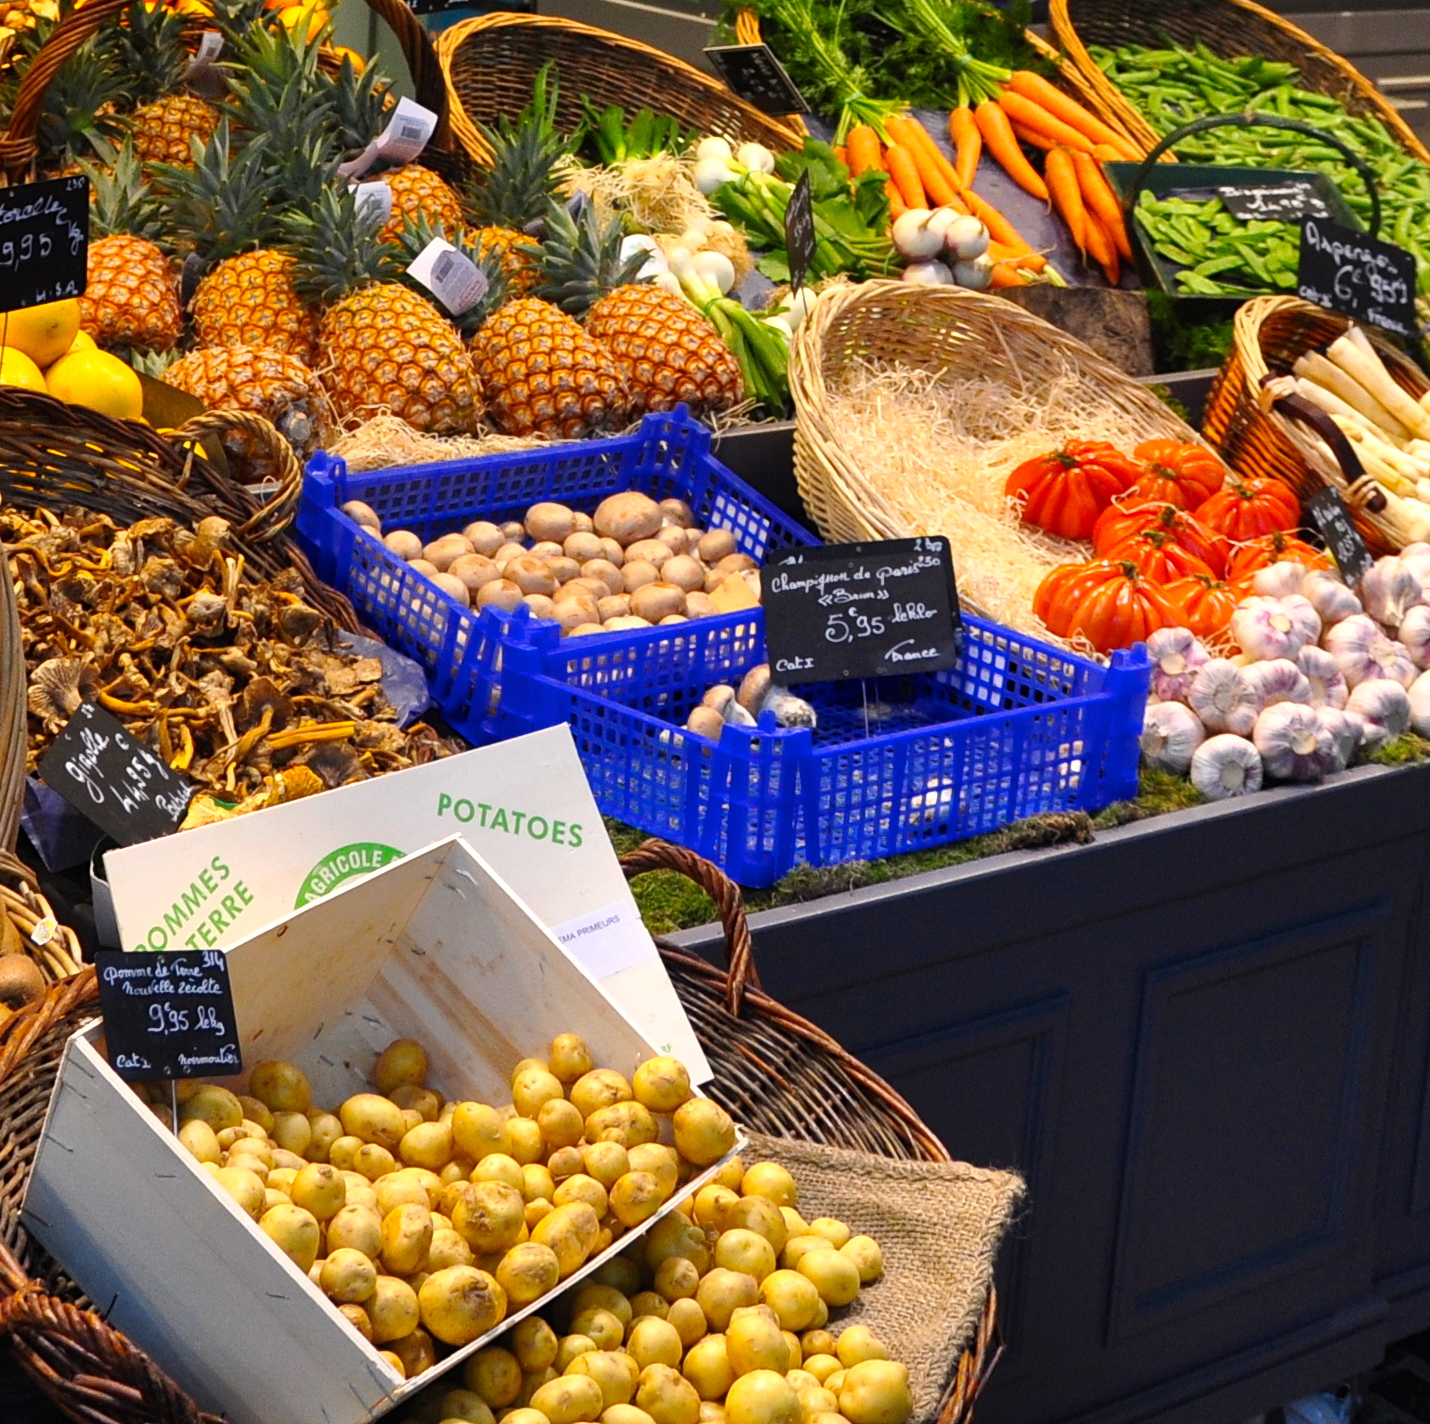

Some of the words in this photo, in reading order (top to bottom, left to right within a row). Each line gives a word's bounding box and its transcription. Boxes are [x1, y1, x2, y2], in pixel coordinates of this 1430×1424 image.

[854, 566, 871, 580] de
[438, 792, 585, 849] POTATOES
[305, 850, 384, 902] AGRICOLE
[184, 879, 255, 952] TERRE
[576, 914, 621, 938] PRIMEURS
[202, 951, 224, 972] 314
